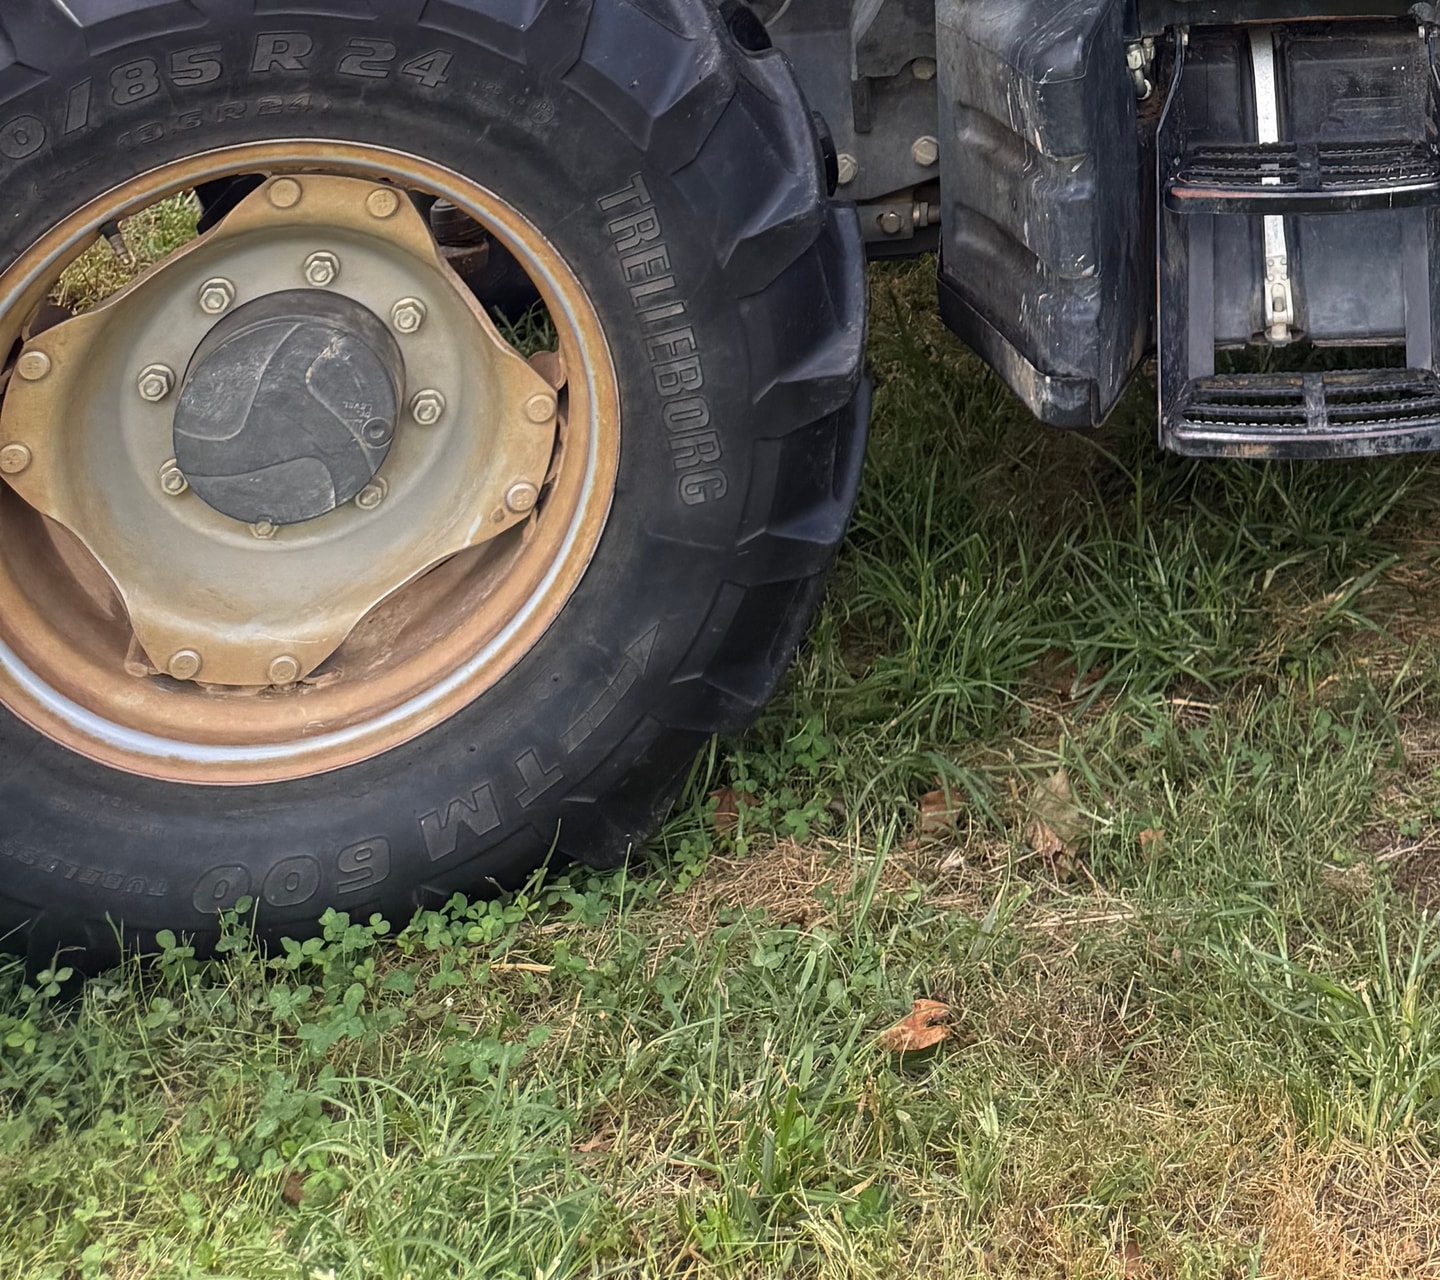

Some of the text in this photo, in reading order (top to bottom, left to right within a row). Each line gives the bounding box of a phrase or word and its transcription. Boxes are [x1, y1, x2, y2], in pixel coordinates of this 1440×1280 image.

[252, 32, 313, 74] R
[338, 39, 455, 89] 24
[597, 171, 729, 506] TRELLEBORG
[193, 749, 564, 914] TM 600
